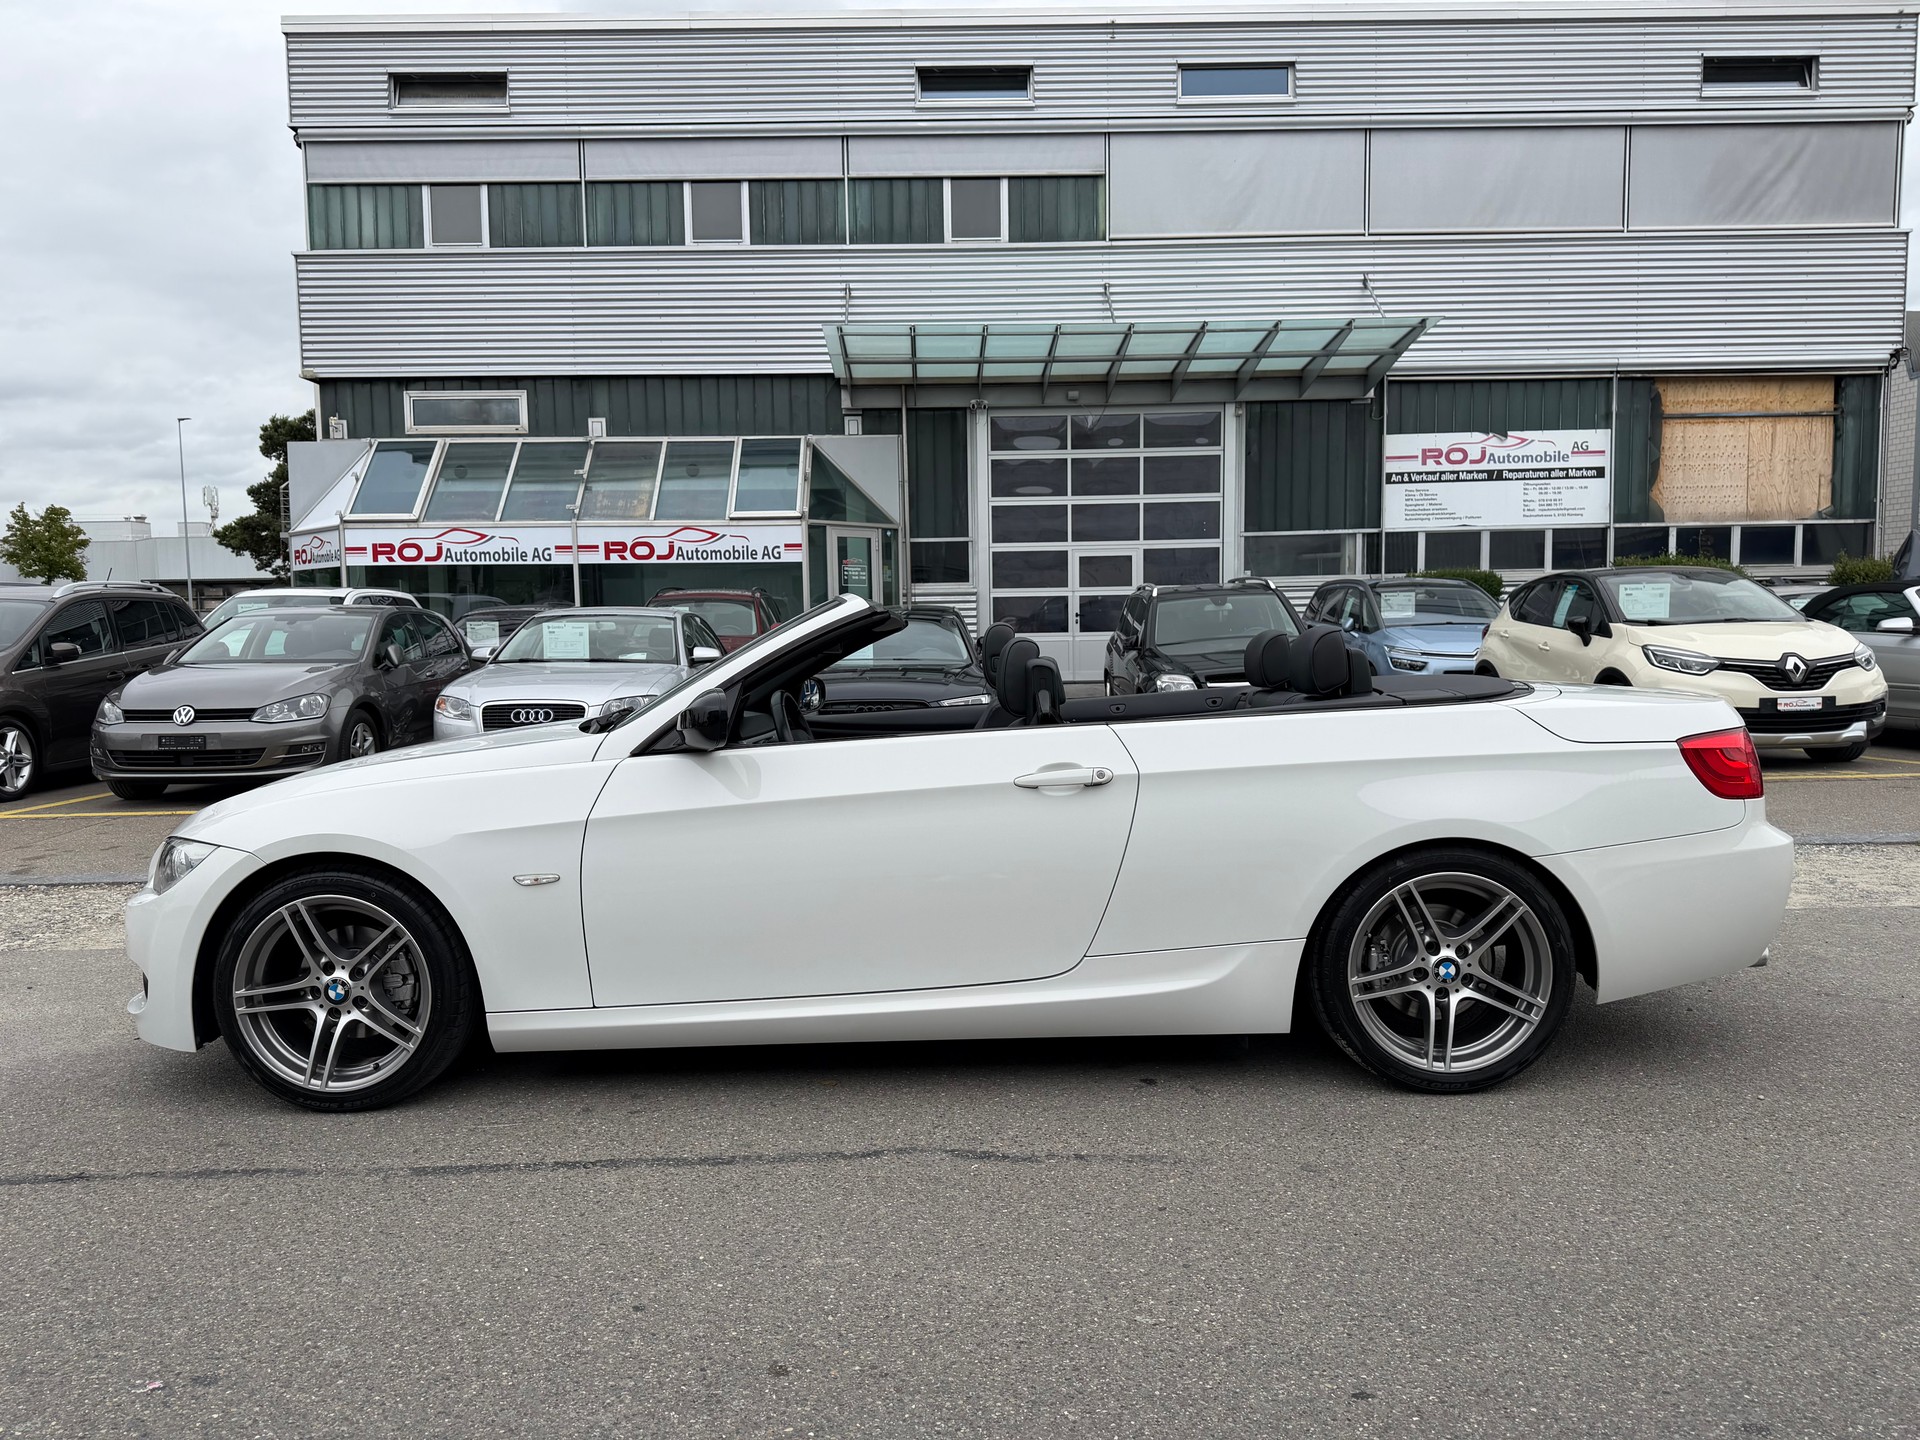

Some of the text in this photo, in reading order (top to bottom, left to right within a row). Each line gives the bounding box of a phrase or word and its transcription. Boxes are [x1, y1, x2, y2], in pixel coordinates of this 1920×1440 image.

[1421, 440, 1589, 466] ROJ Automobile AG
[1390, 474, 1402, 482] An
[1403, 474, 1410, 482] &
[1410, 472, 1440, 482] Verkauf
[1441, 472, 1458, 480] aller
[1459, 471, 1488, 480] Marken
[1502, 470, 1550, 480] Reparaturen
[1550, 469, 1567, 478] aller
[1568, 468, 1597, 477] Marken
[294, 548, 312, 566] ROJ
[372, 542, 552, 563] ROJ Automobile AG
[604, 541, 782, 561] ROJ Automobile AG
